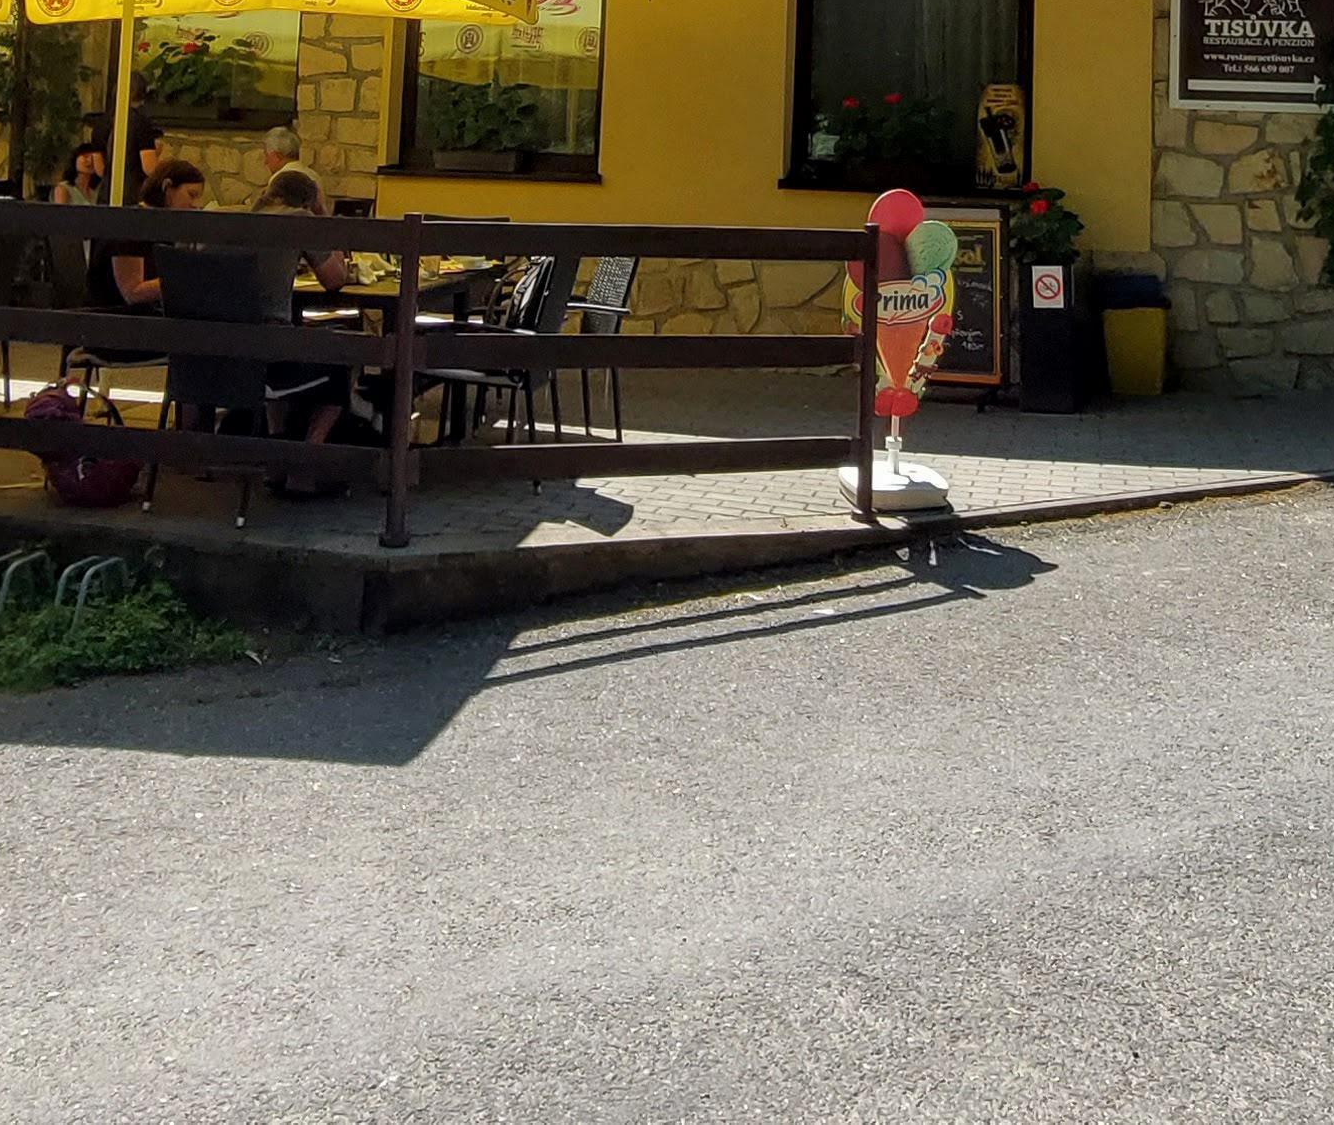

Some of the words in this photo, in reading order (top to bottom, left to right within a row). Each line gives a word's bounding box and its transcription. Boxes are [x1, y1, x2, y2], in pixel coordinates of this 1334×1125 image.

[1204, 14, 1316, 38] TISŮVKA
[1203, 36, 1263, 46] RESTAURACE
[1263, 38, 1271, 47] A
[1272, 38, 1315, 47] PENZION
